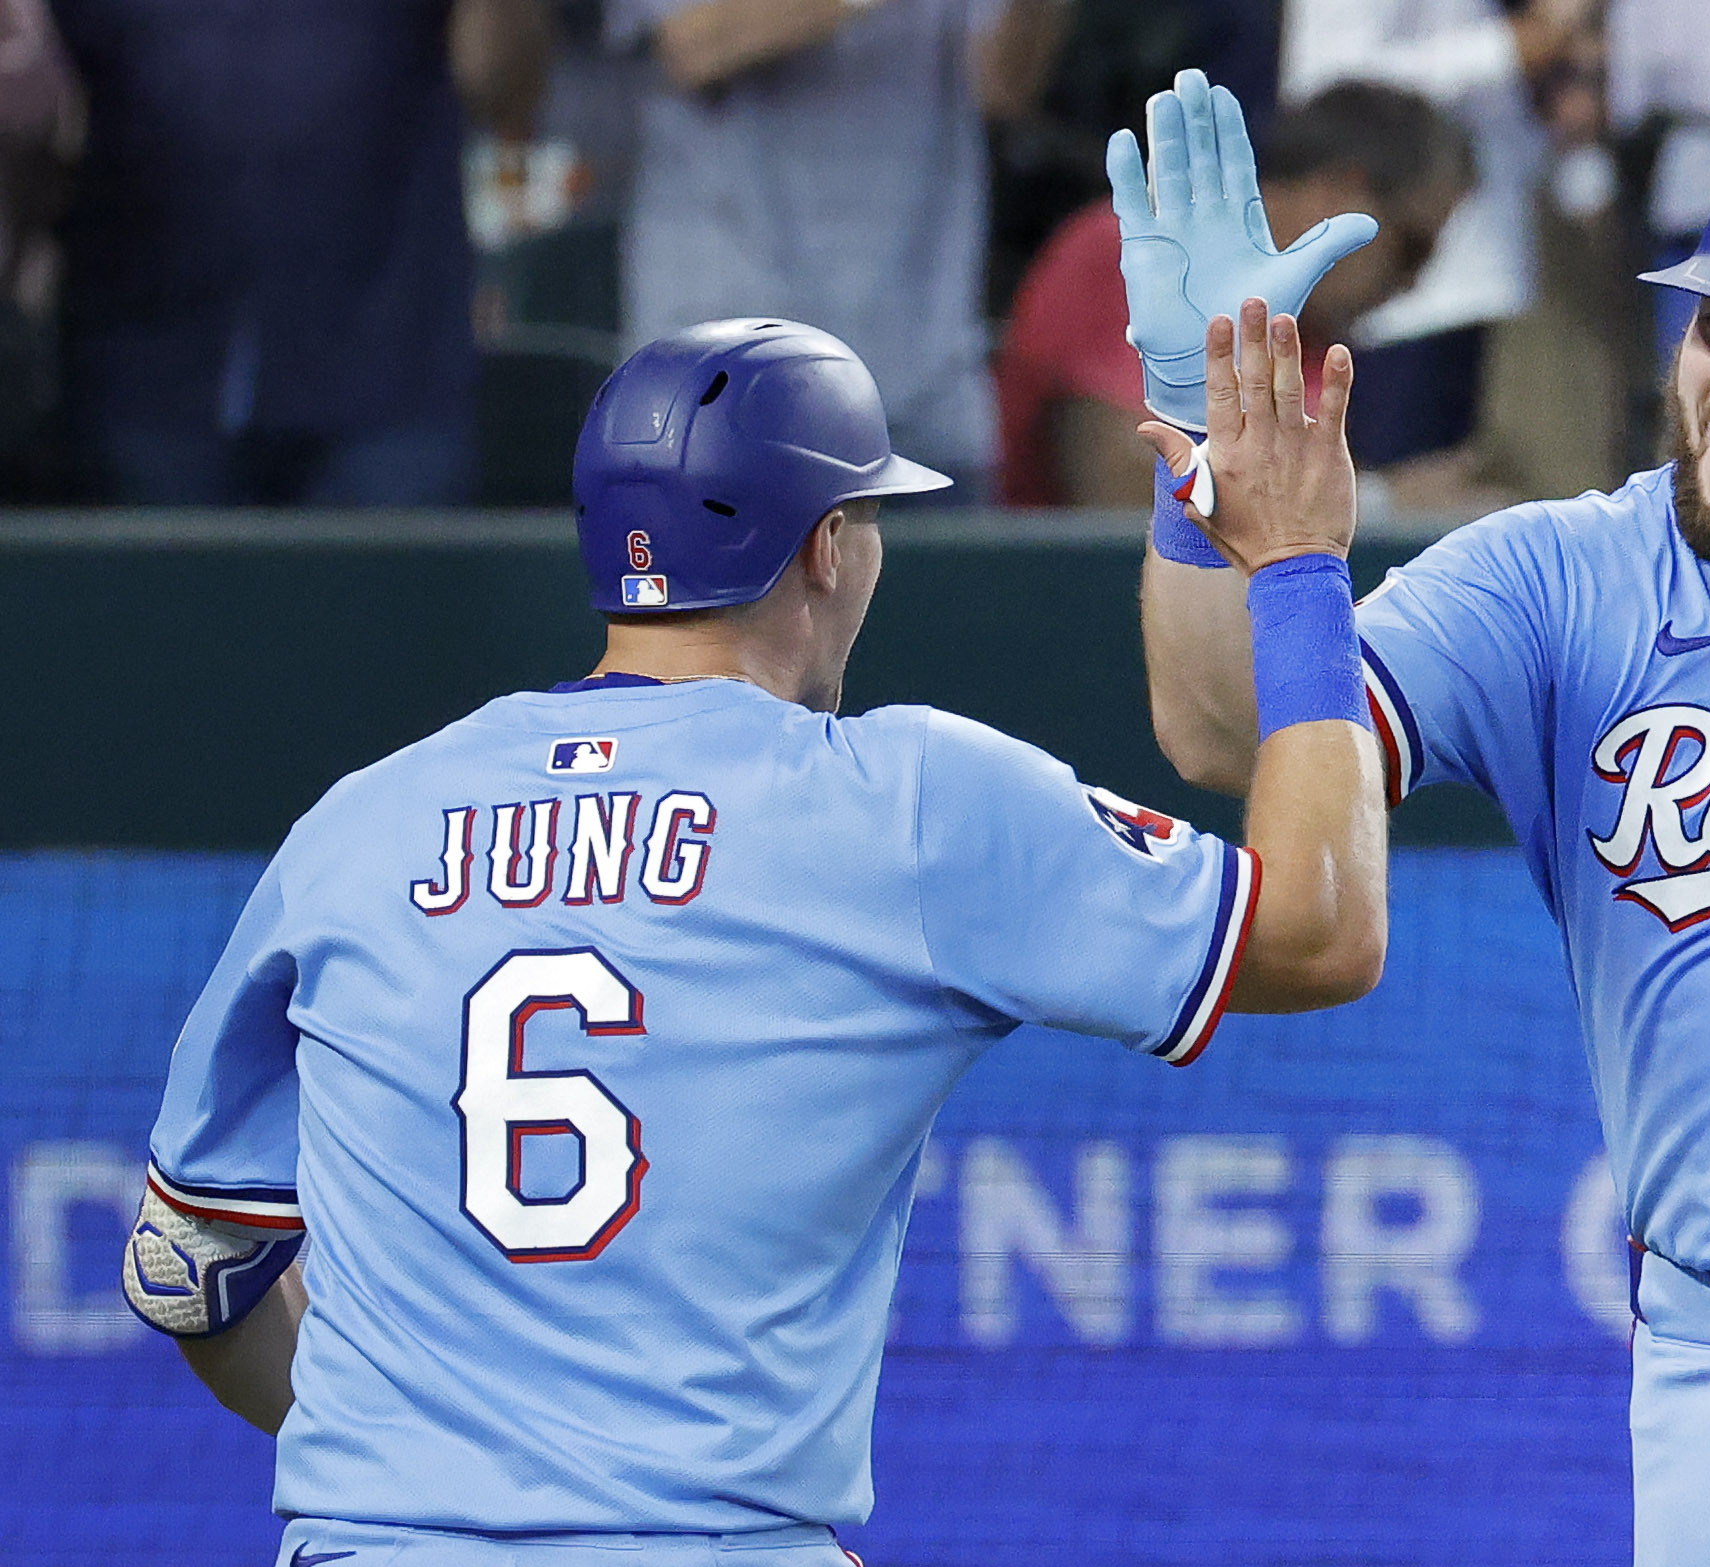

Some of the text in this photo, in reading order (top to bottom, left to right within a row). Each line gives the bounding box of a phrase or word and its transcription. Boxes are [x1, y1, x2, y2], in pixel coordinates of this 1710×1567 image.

[627, 529, 653, 571] 6
[409, 789, 718, 917] JUNG
[449, 946, 650, 1264] 6
[922, 1130, 1486, 1348] NER
